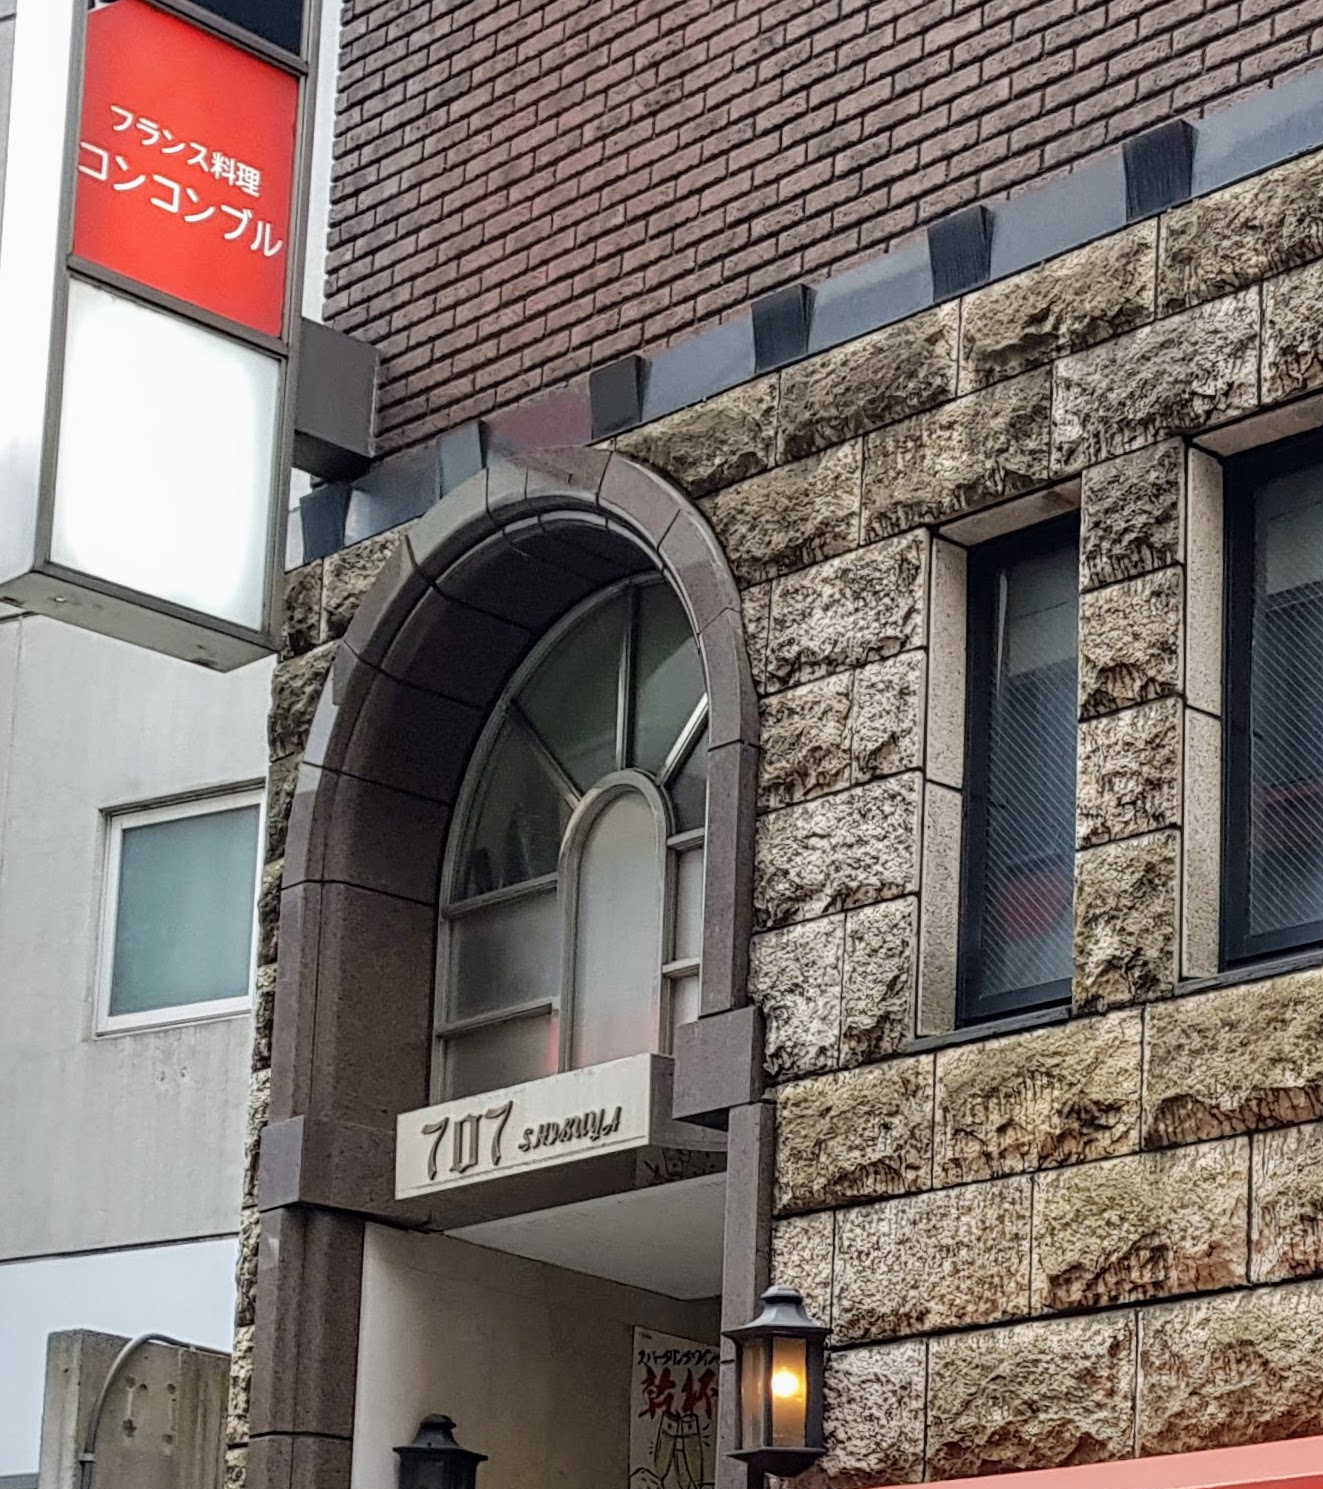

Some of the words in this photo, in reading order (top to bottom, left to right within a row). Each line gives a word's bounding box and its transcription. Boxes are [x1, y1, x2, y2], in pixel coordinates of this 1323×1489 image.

[109, 105, 262, 198] フランス料理
[77, 140, 283, 258] コンコンブル
[421, 1100, 514, 1180] 707
[518, 1106, 622, 1152] SHIBUYA
